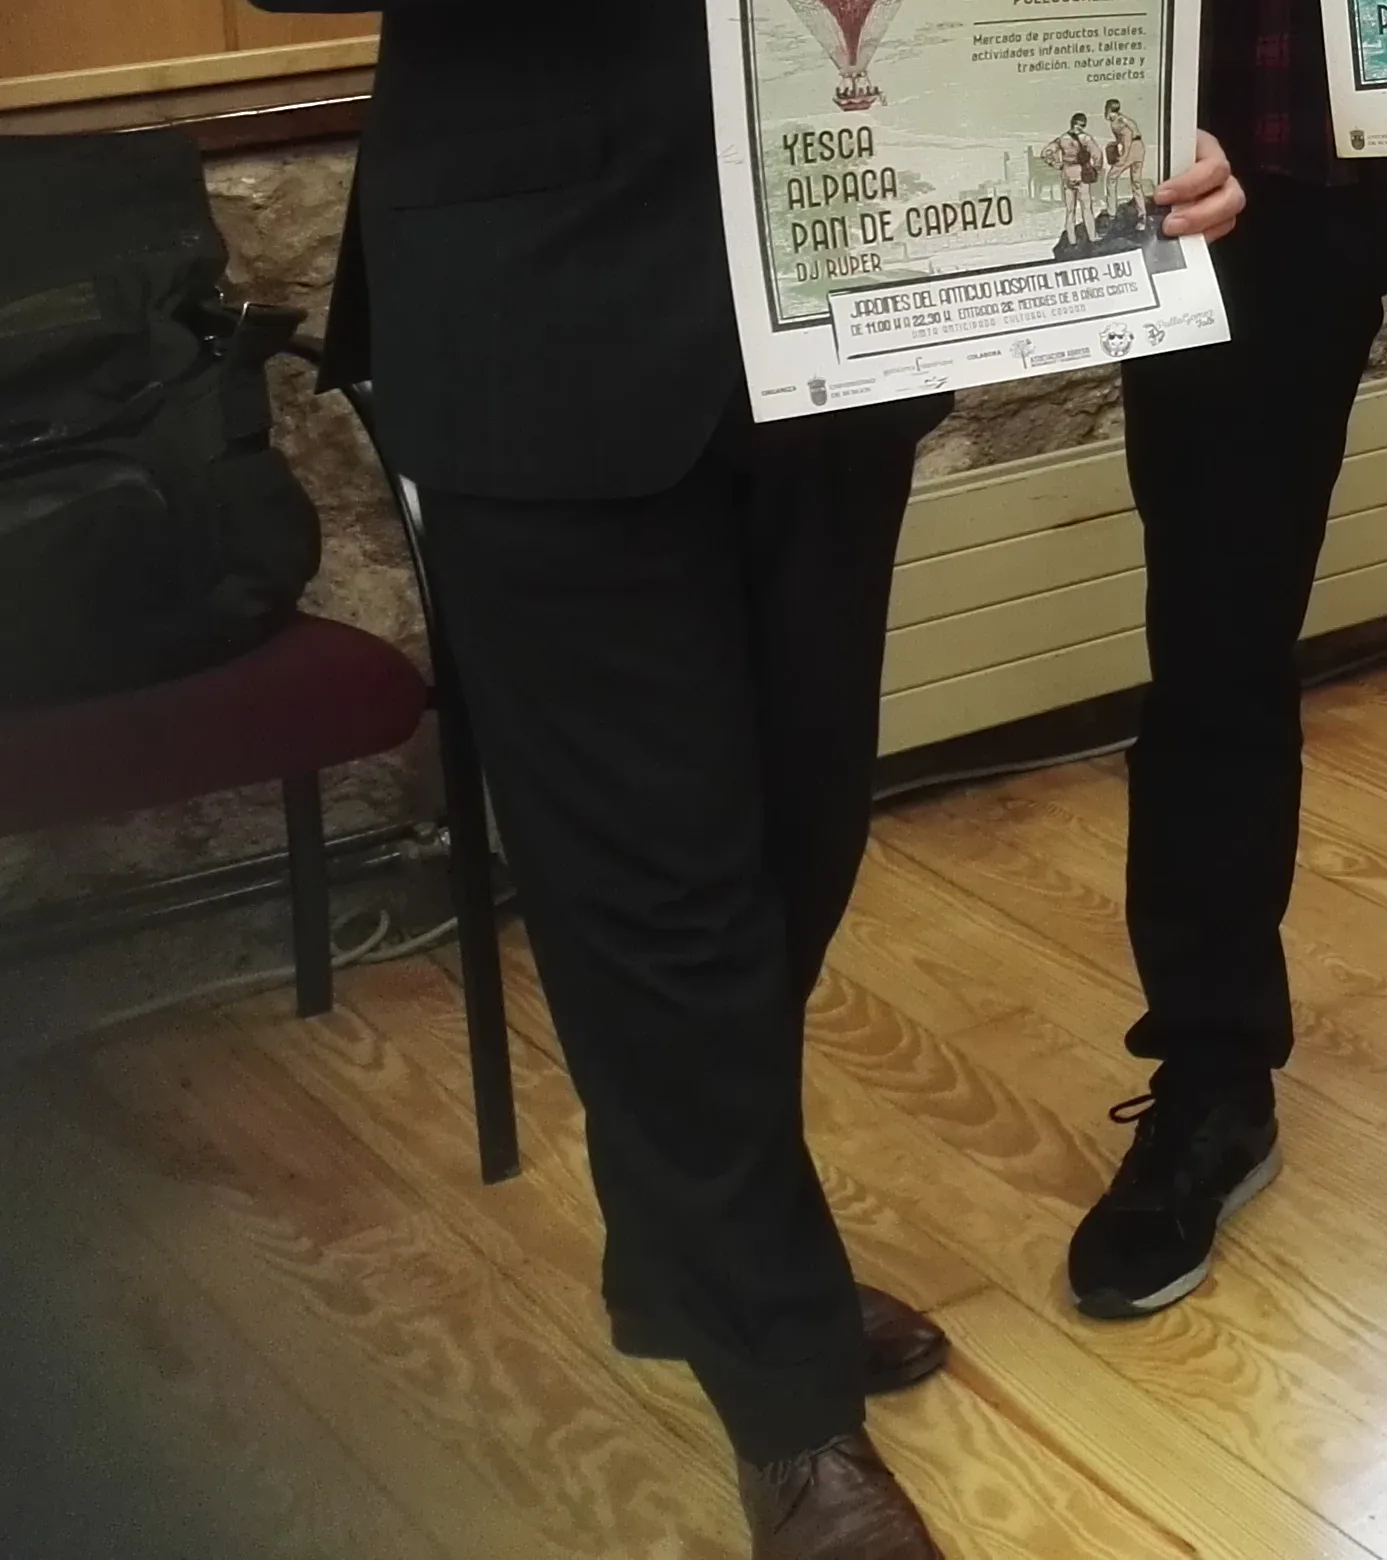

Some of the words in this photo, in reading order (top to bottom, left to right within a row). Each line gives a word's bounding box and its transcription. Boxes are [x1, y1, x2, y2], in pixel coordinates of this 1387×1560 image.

[973, 32, 1021, 45] Mercado
[1042, 28, 1098, 41] productos
[972, 47, 1034, 63] actividades
[1074, 56, 1134, 68] naturaleza
[1087, 70, 1144, 82] conciertos
[783, 124, 874, 167] YESCA
[786, 166, 898, 210] ALPACA
[791, 216, 848, 255] PAN
[860, 209, 894, 245] DE
[905, 195, 1014, 238] CAPAZO
[796, 261, 820, 283] DJ
[825, 251, 882, 278] RUPER
